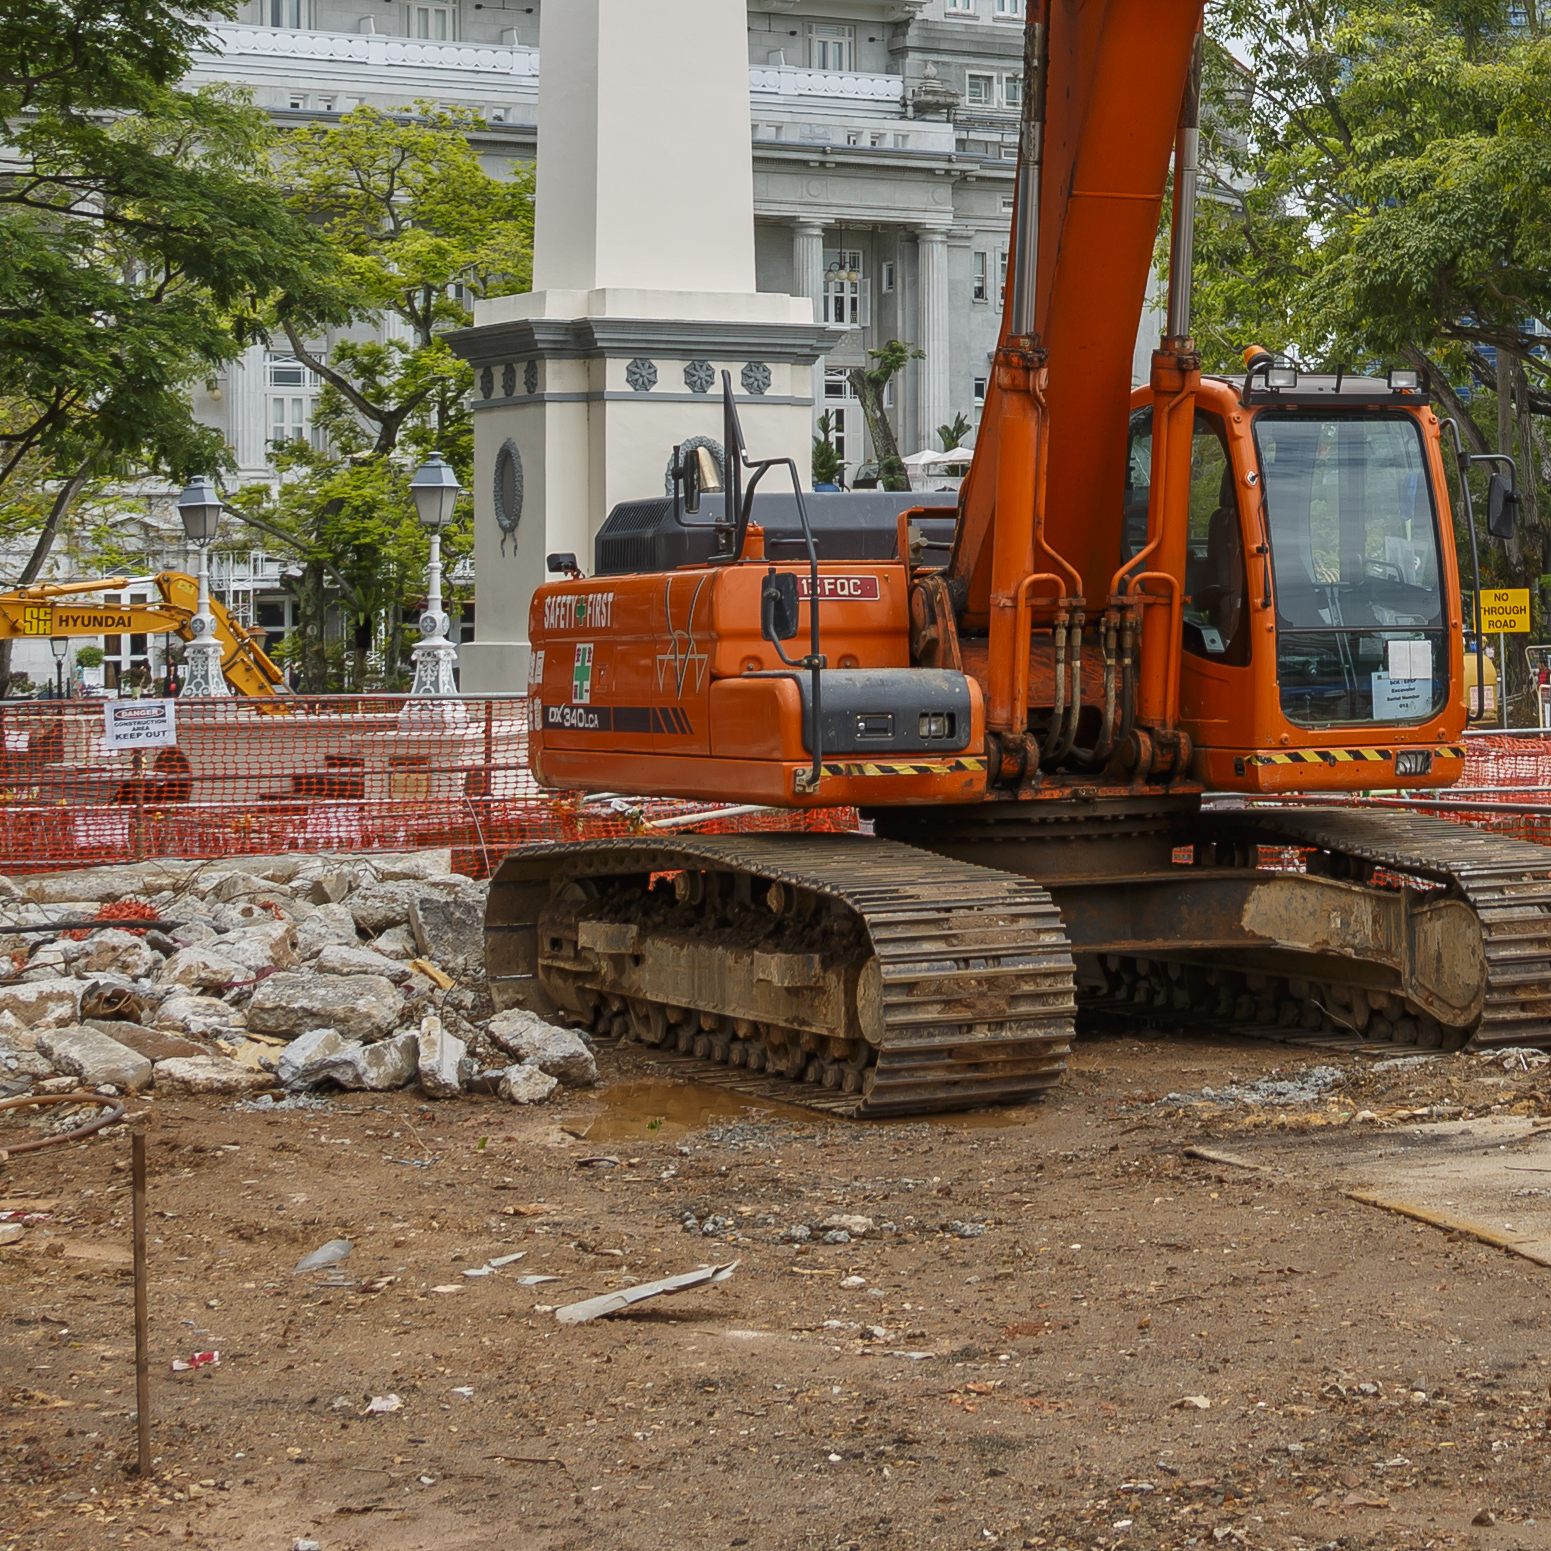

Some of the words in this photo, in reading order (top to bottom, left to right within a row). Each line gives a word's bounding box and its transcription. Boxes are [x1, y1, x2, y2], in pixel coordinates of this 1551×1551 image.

[823, 579, 861, 595] FQC
[1494, 593, 1509, 602] NO
[544, 595, 577, 630] SAFETY
[586, 592, 614, 628] FIRST
[1480, 605, 1527, 616] HROUGH
[59, 615, 132, 628] HYUNDAI
[1488, 619, 1517, 629] ROAD
[121, 709, 158, 717] DANGER
[114, 719, 167, 727] CONSTRUCTION
[115, 732, 142, 740] KEEP
[145, 730, 168, 738] OUT
